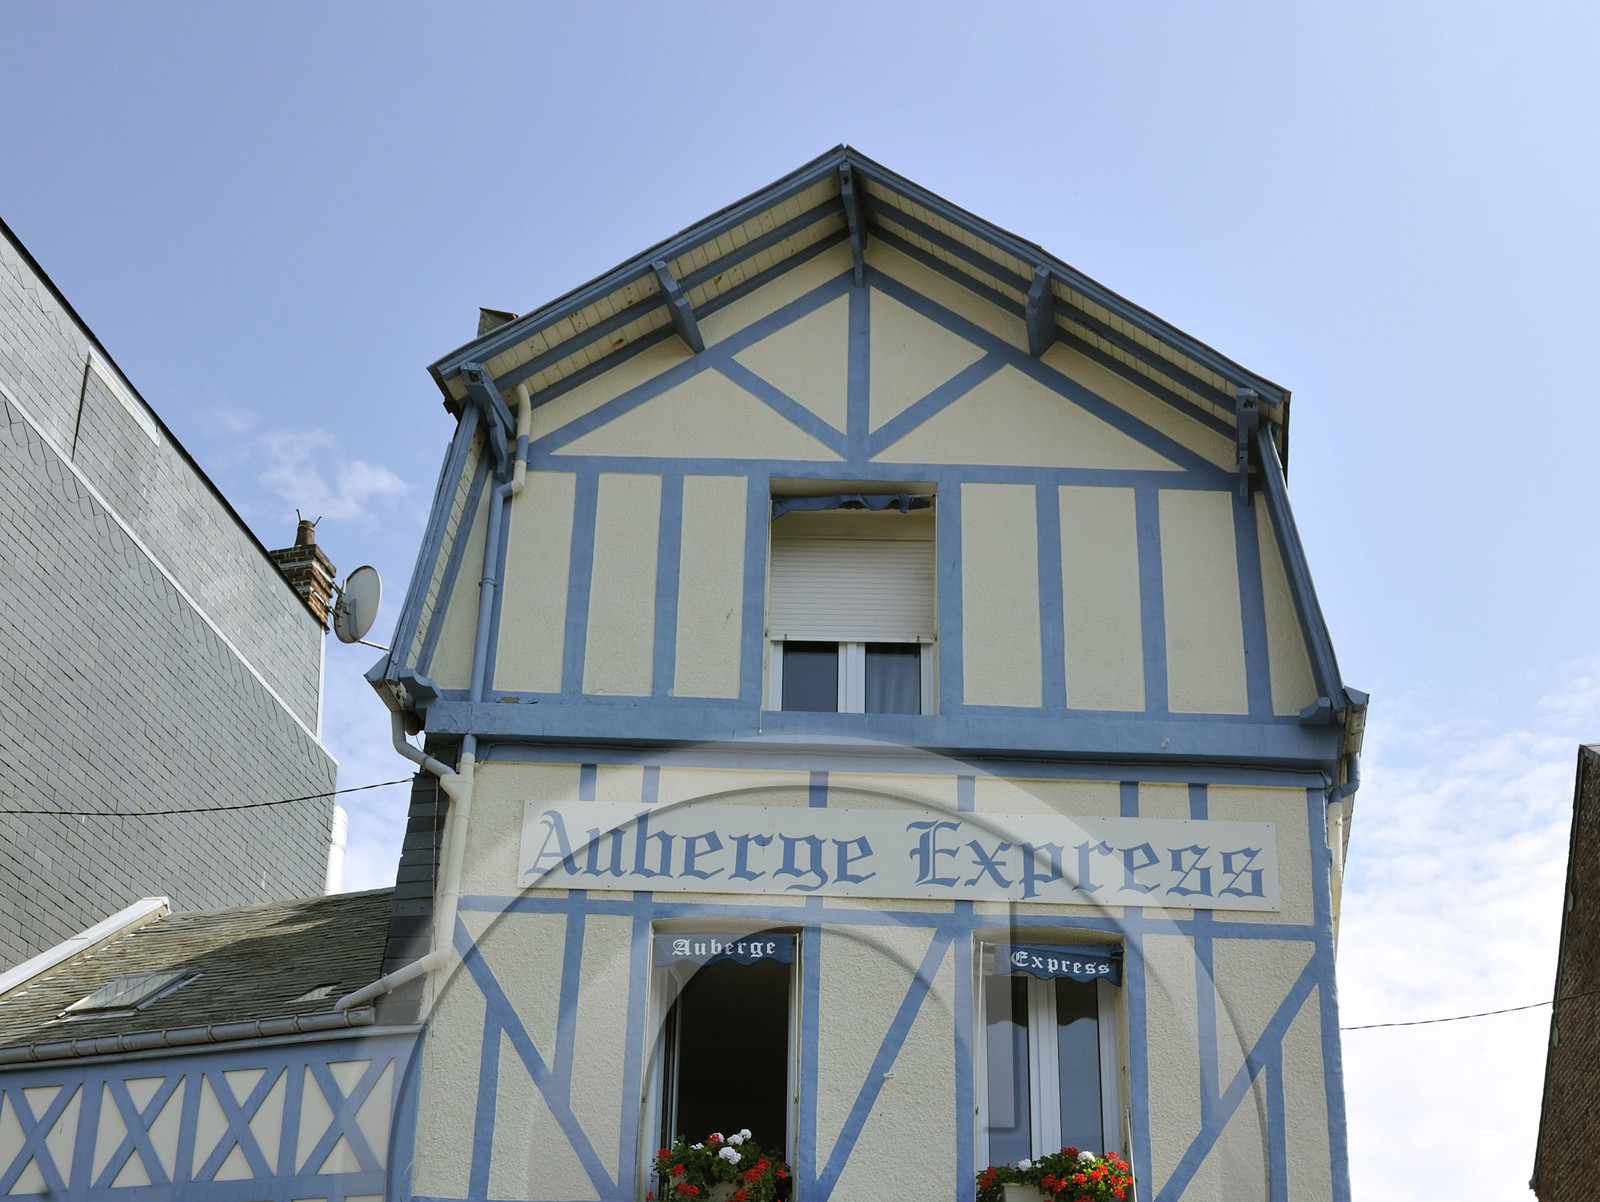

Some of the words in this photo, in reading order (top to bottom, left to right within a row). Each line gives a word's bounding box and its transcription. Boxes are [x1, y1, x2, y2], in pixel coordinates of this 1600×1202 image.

[530, 809, 877, 891] Auberge
[906, 820, 1265, 898] Express
[671, 937, 777, 960] Auberge
[1010, 951, 1112, 977] Express
